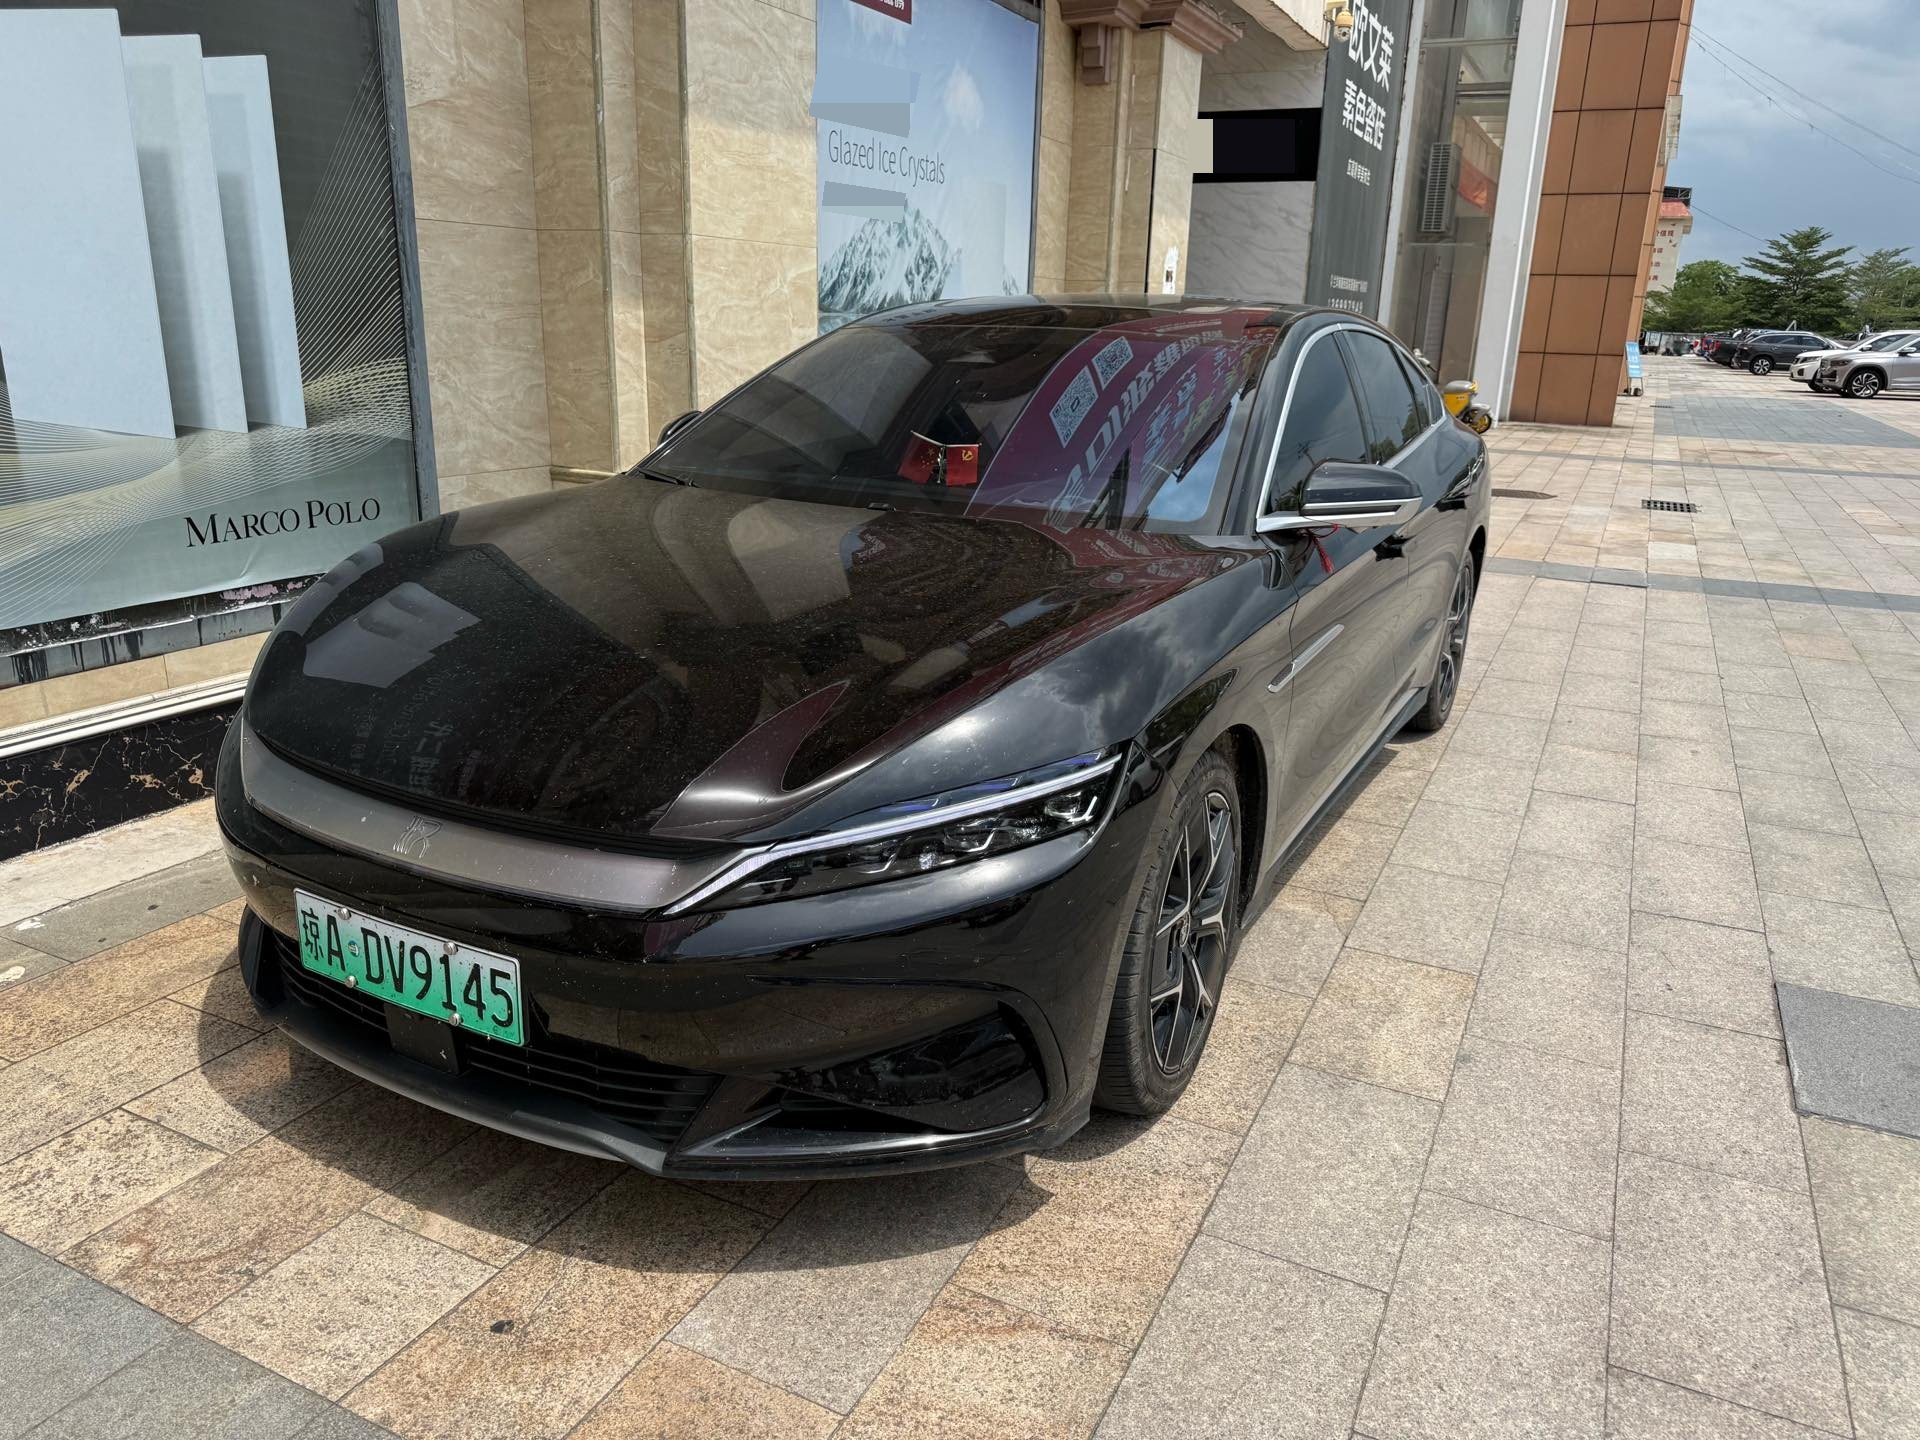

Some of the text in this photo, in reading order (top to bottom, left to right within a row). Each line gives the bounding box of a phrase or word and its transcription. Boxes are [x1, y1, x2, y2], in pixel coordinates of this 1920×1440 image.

[1342, 78, 1386, 151] 素色瓷砖
[828, 129, 945, 187] Glazed Ice Crystals
[184, 498, 380, 547] MARCO POLO
